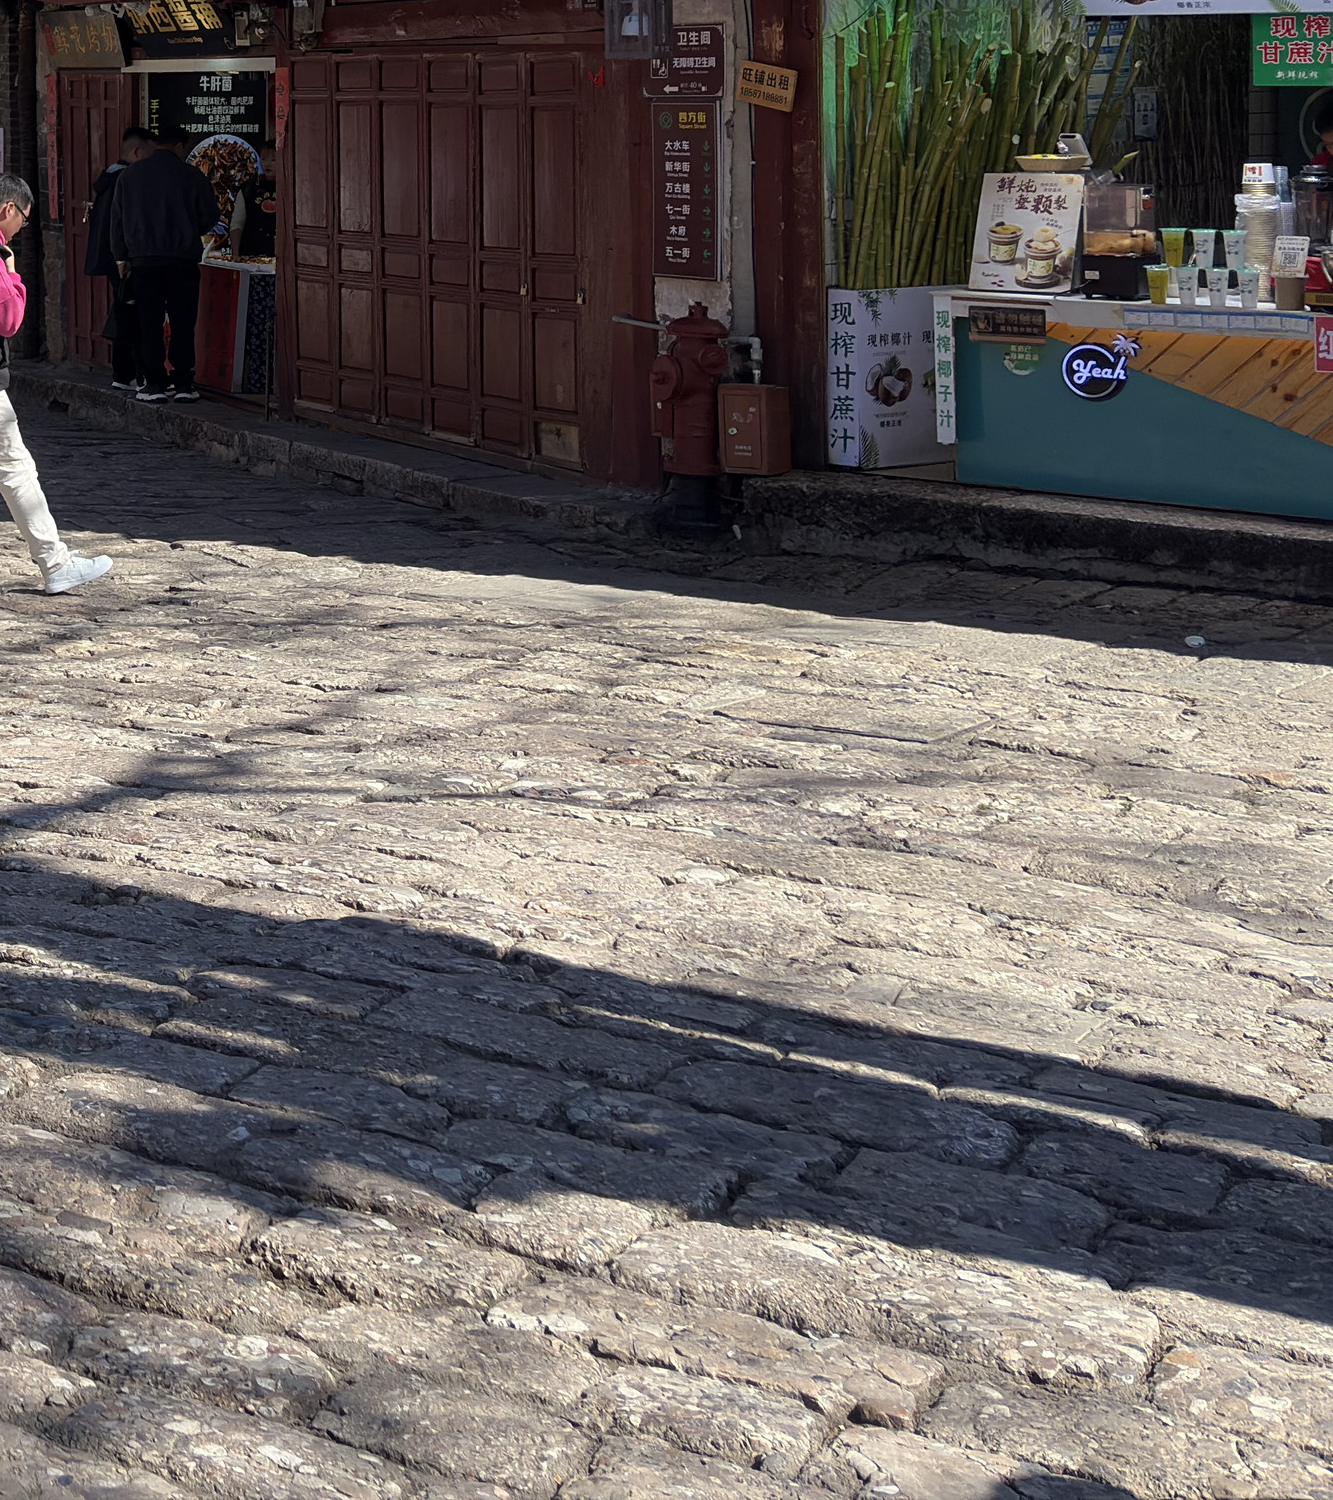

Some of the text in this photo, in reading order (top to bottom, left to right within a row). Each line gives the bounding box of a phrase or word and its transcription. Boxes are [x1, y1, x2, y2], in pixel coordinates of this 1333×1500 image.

[1271, 15, 1331, 38] 现榨
[677, 31, 711, 46] 卫生间
[1258, 42, 1333, 64] 甘蔗汁
[672, 57, 716, 68] 无障碍卫生间
[200, 75, 233, 92] 牛肝菌
[742, 67, 790, 91] 旺铺出租
[678, 112, 706, 124] 四方街
[665, 140, 690, 151] 大水车
[665, 161, 690, 172] 新华街
[665, 182, 690, 193] 万古楼
[665, 204, 690, 215] 七一街
[669, 225, 686, 236] 木府
[665, 246, 690, 258] 五一街
[867, 332, 912, 348] 现榨椰汁
[936, 310, 954, 428] 现榨椰子汁
[1072, 355, 1127, 385] Yeah
[830, 302, 857, 454] 现榨甘蔗汁
